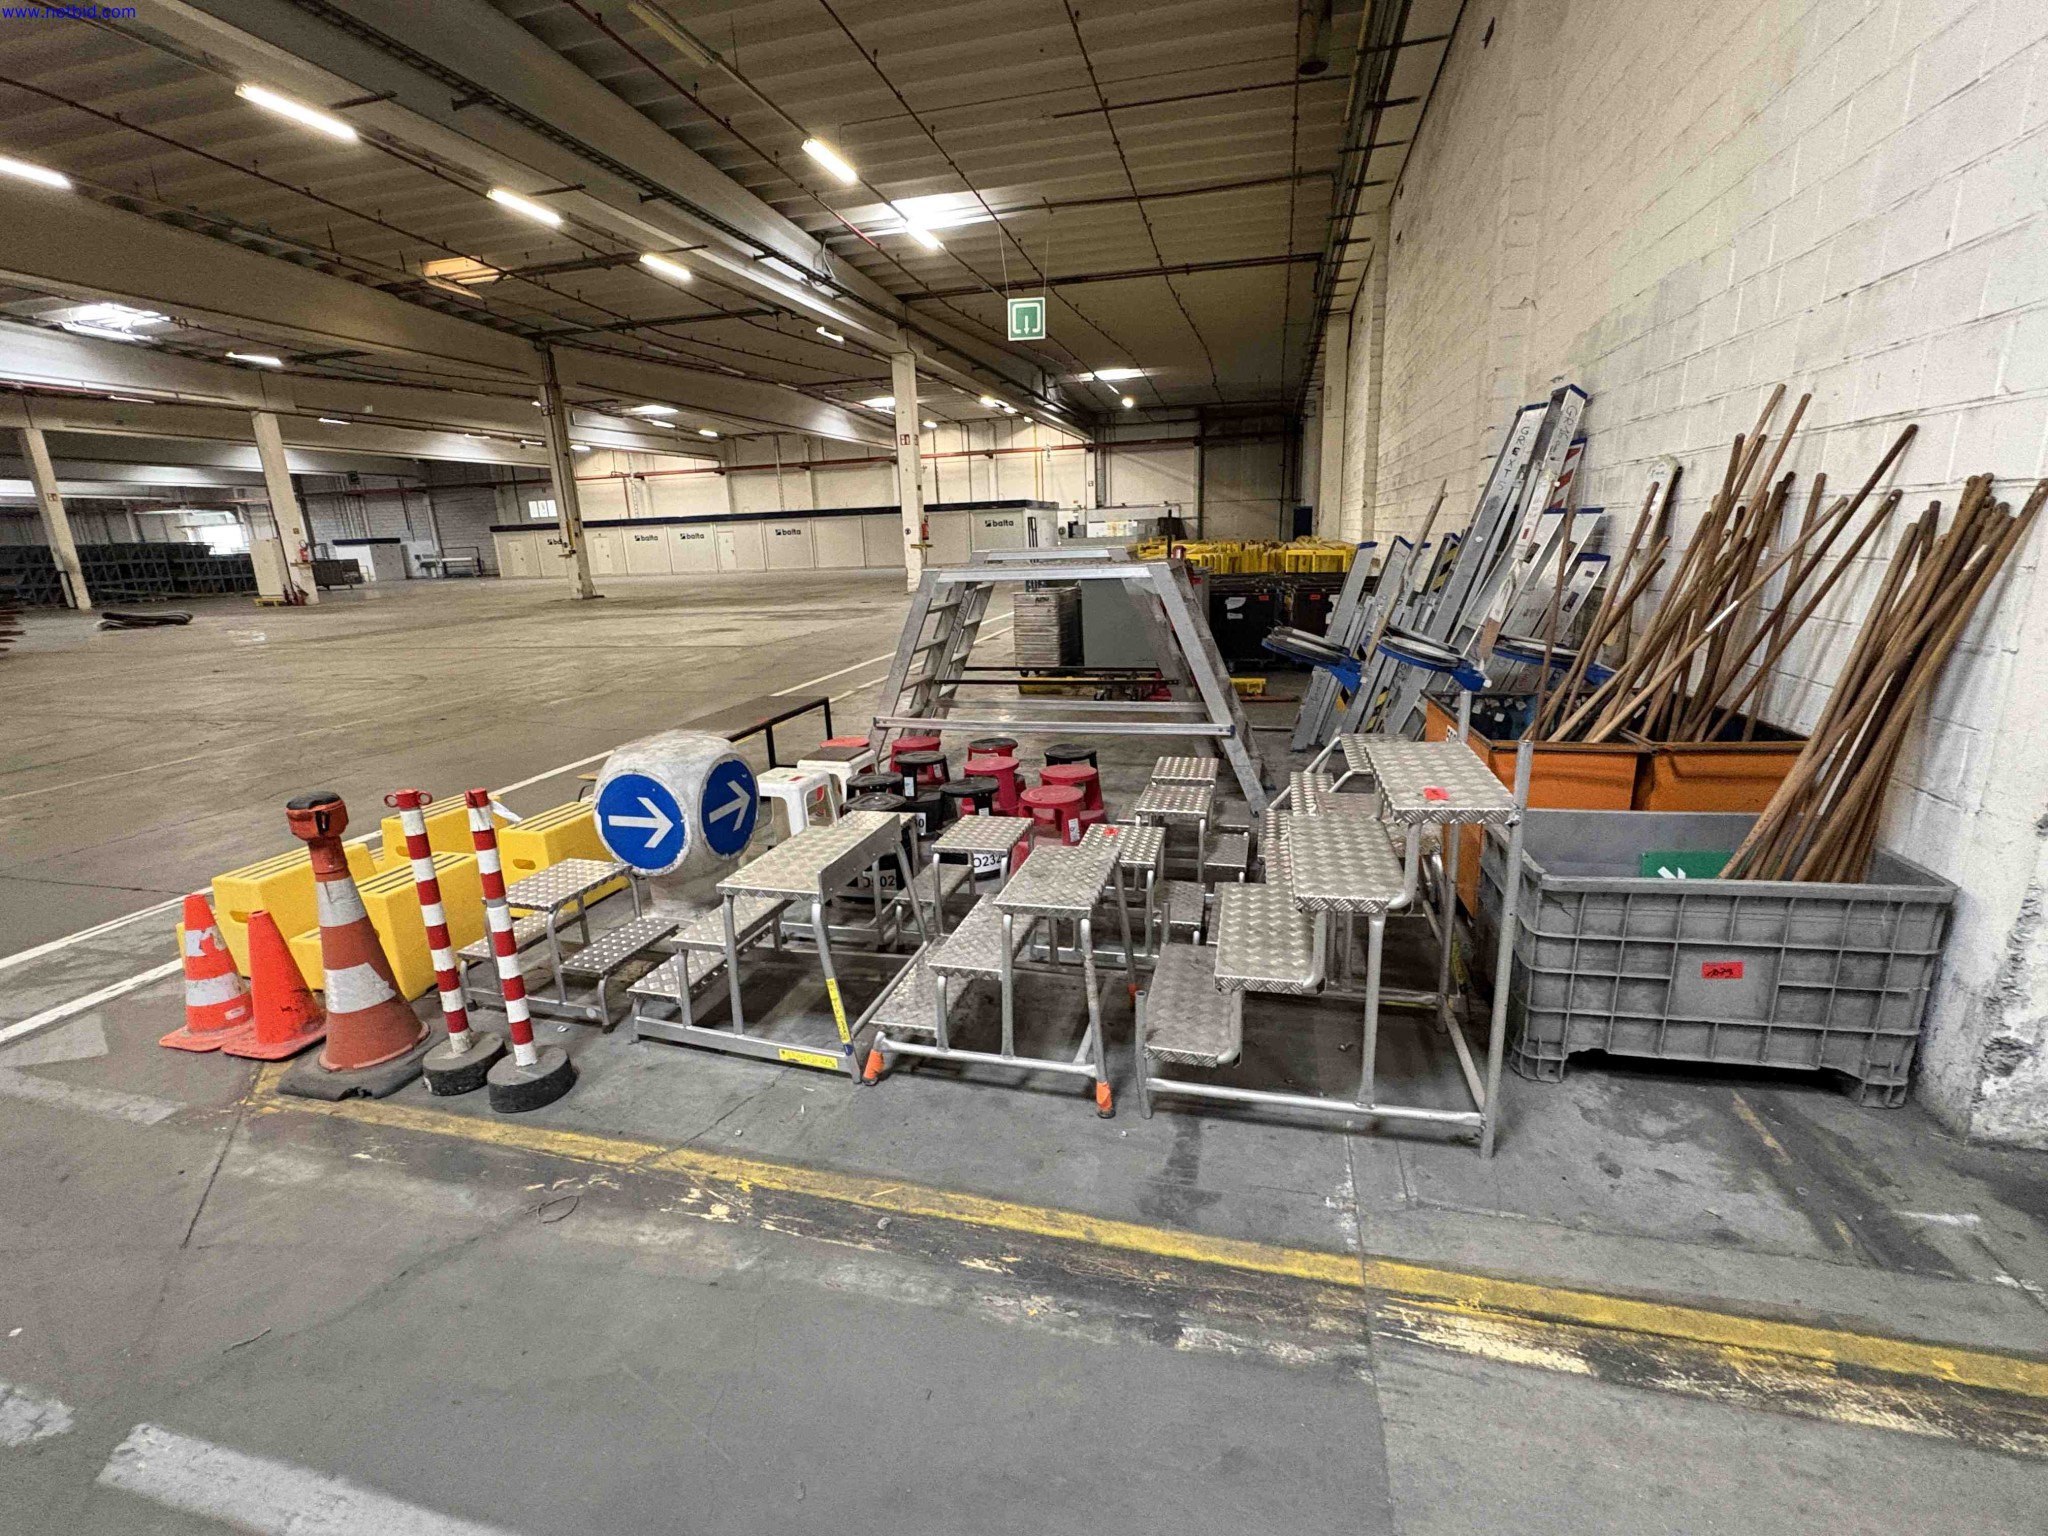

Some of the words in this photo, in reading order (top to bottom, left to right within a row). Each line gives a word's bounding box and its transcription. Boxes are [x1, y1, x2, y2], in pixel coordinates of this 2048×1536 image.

[992, 519, 1014, 528] balta
[686, 532, 705, 540] balta
[782, 528, 801, 536] balta
[640, 534, 658, 542] balta
